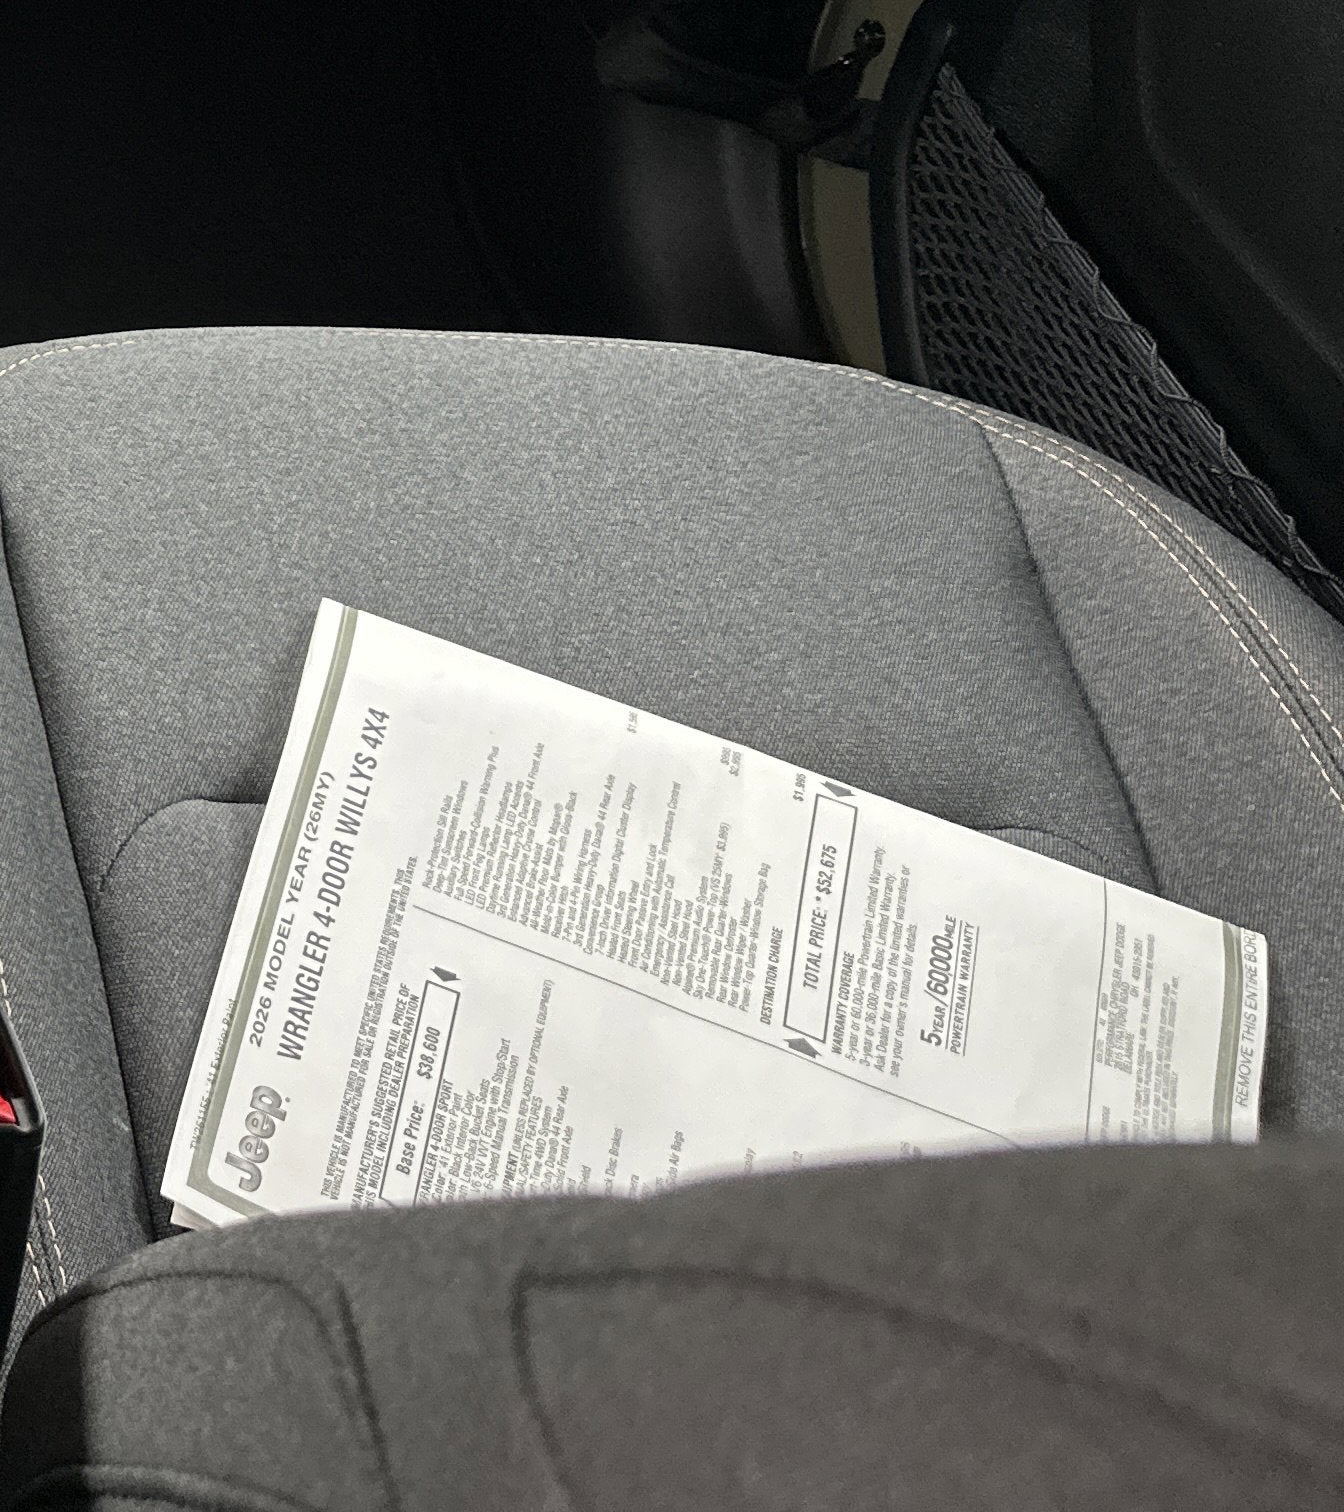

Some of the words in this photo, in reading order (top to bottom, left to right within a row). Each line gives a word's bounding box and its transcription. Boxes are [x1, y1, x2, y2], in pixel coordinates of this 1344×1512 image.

[277, 929, 331, 1063] WRANGLER
[310, 838, 354, 929] 4-DOOR
[334, 749, 378, 839] WILLYS
[359, 705, 390, 751] 4X4
[815, 842, 839, 896] $52,675
[247, 994, 273, 1048] 2026
[263, 909, 295, 991] MODEL
[285, 844, 311, 906] YEAR
[302, 769, 335, 843] (26MY)
[864, 884, 879, 919] Limited
[767, 925, 784, 963] CHARGE
[807, 905, 828, 948] PRICE:
[857, 918, 874, 966] Powertrain
[957, 921, 976, 981] WARRANTY
[758, 963, 780, 1025] DESTINATION
[802, 948, 823, 991] TOTAL
[837, 950, 855, 1001] COVERAGE
[1240, 962, 1259, 1010] ENTIRE
[829, 1000, 849, 1055] WARRANTY
[948, 982, 969, 1055] POWERTRAIN
[1240, 1010, 1256, 1043] THIS
[416, 1025, 442, 1079] $38,600
[844, 1031, 859, 1061] 5-year
[497, 1053, 520, 1115] Transmission
[1235, 1044, 1253, 1107] REMOVE
[219, 1077, 291, 1198] Jeep
[403, 1098, 425, 1139] Price:
[490, 1115, 507, 1151] Manual
[395, 1139, 416, 1175] Base
[483, 1150, 502, 1191] 6-Speed
